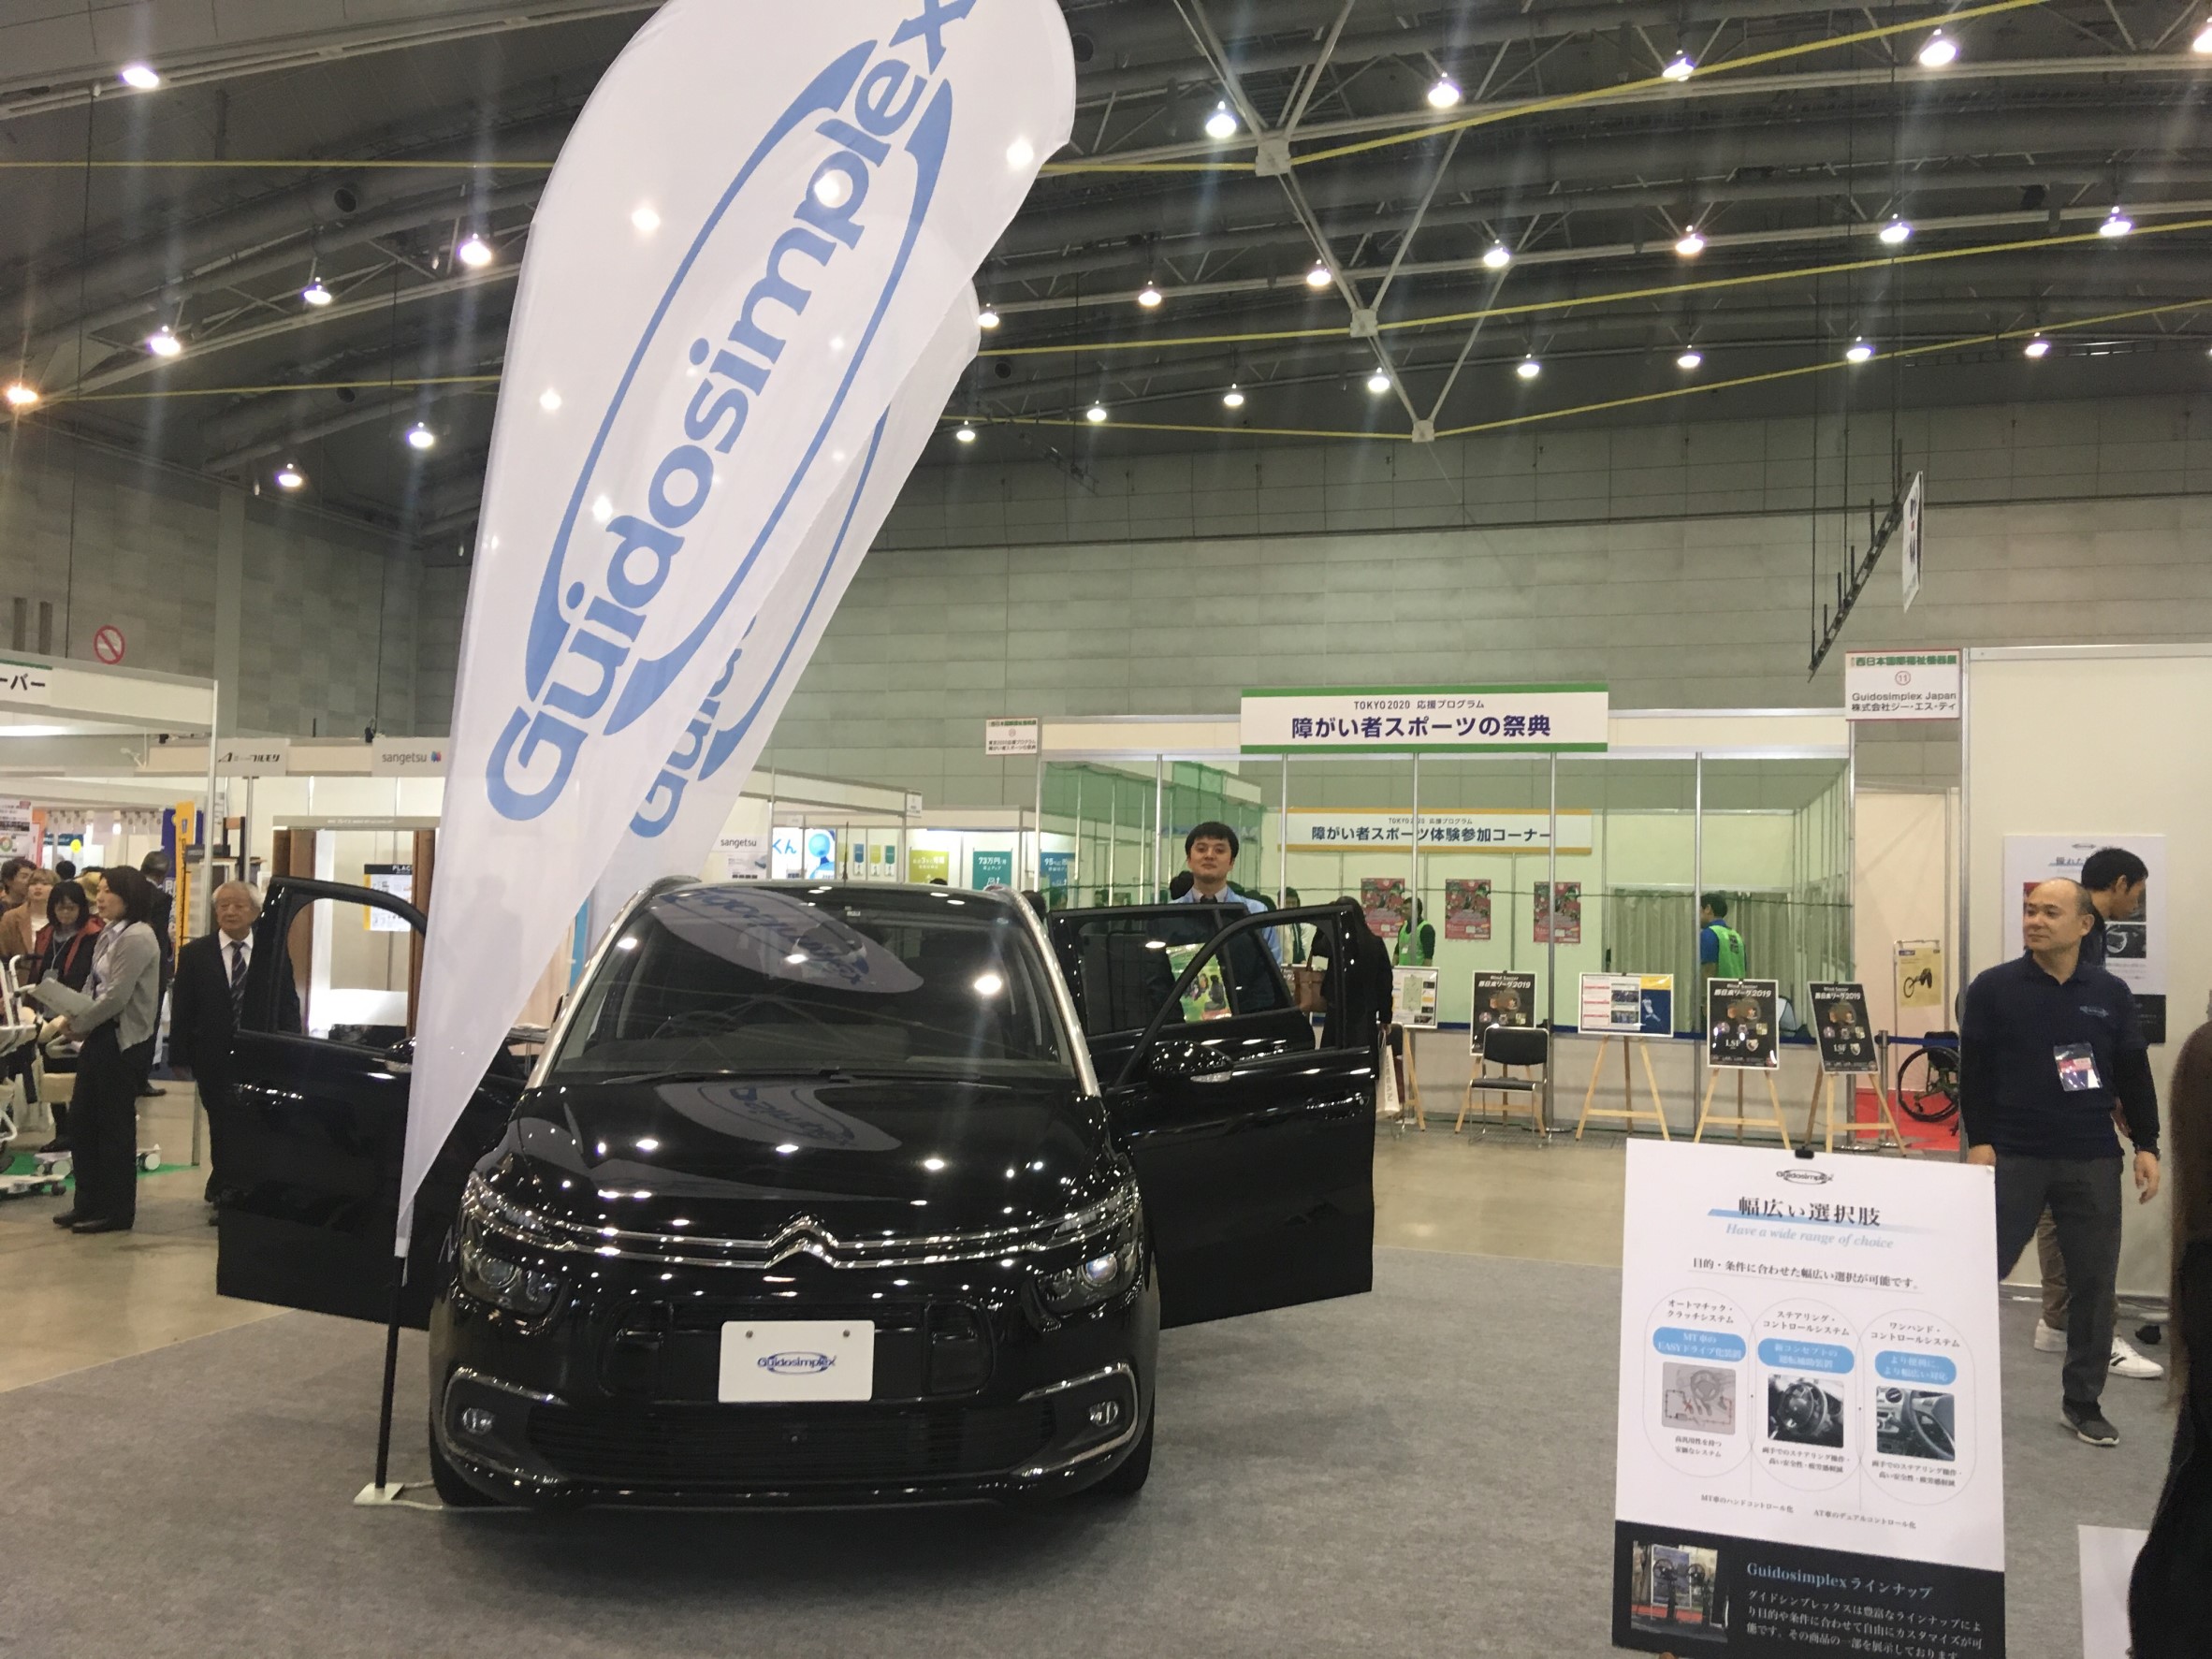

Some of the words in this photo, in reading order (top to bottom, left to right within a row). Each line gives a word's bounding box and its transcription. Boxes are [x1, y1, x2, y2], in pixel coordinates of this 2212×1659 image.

[486, 0, 976, 821] Guidosimplex
[1354, 700, 1410, 710] TOKYO2020
[1417, 699, 1485, 709] 応援プログラム
[1852, 692, 1922, 703] Guidosimplex
[1925, 691, 1957, 702] Japan
[1291, 715, 1550, 739] 障がい者スポーツの祭典
[382, 752, 427, 764] sangetsu
[720, 838, 757, 849] sangetsu
[1739, 1196, 1881, 1227] 幅広い選択肢
[1725, 1223, 1756, 1236] Have
[1759, 1229, 1767, 1237] a
[1769, 1226, 1797, 1240] wide
[1799, 1232, 1834, 1244] range
[1838, 1233, 1854, 1247] of
[1854, 1235, 1894, 1249] choice
[1763, 1320, 1849, 1336] コントロールシステム
[1747, 1562, 1847, 1588] Guidosimplex
